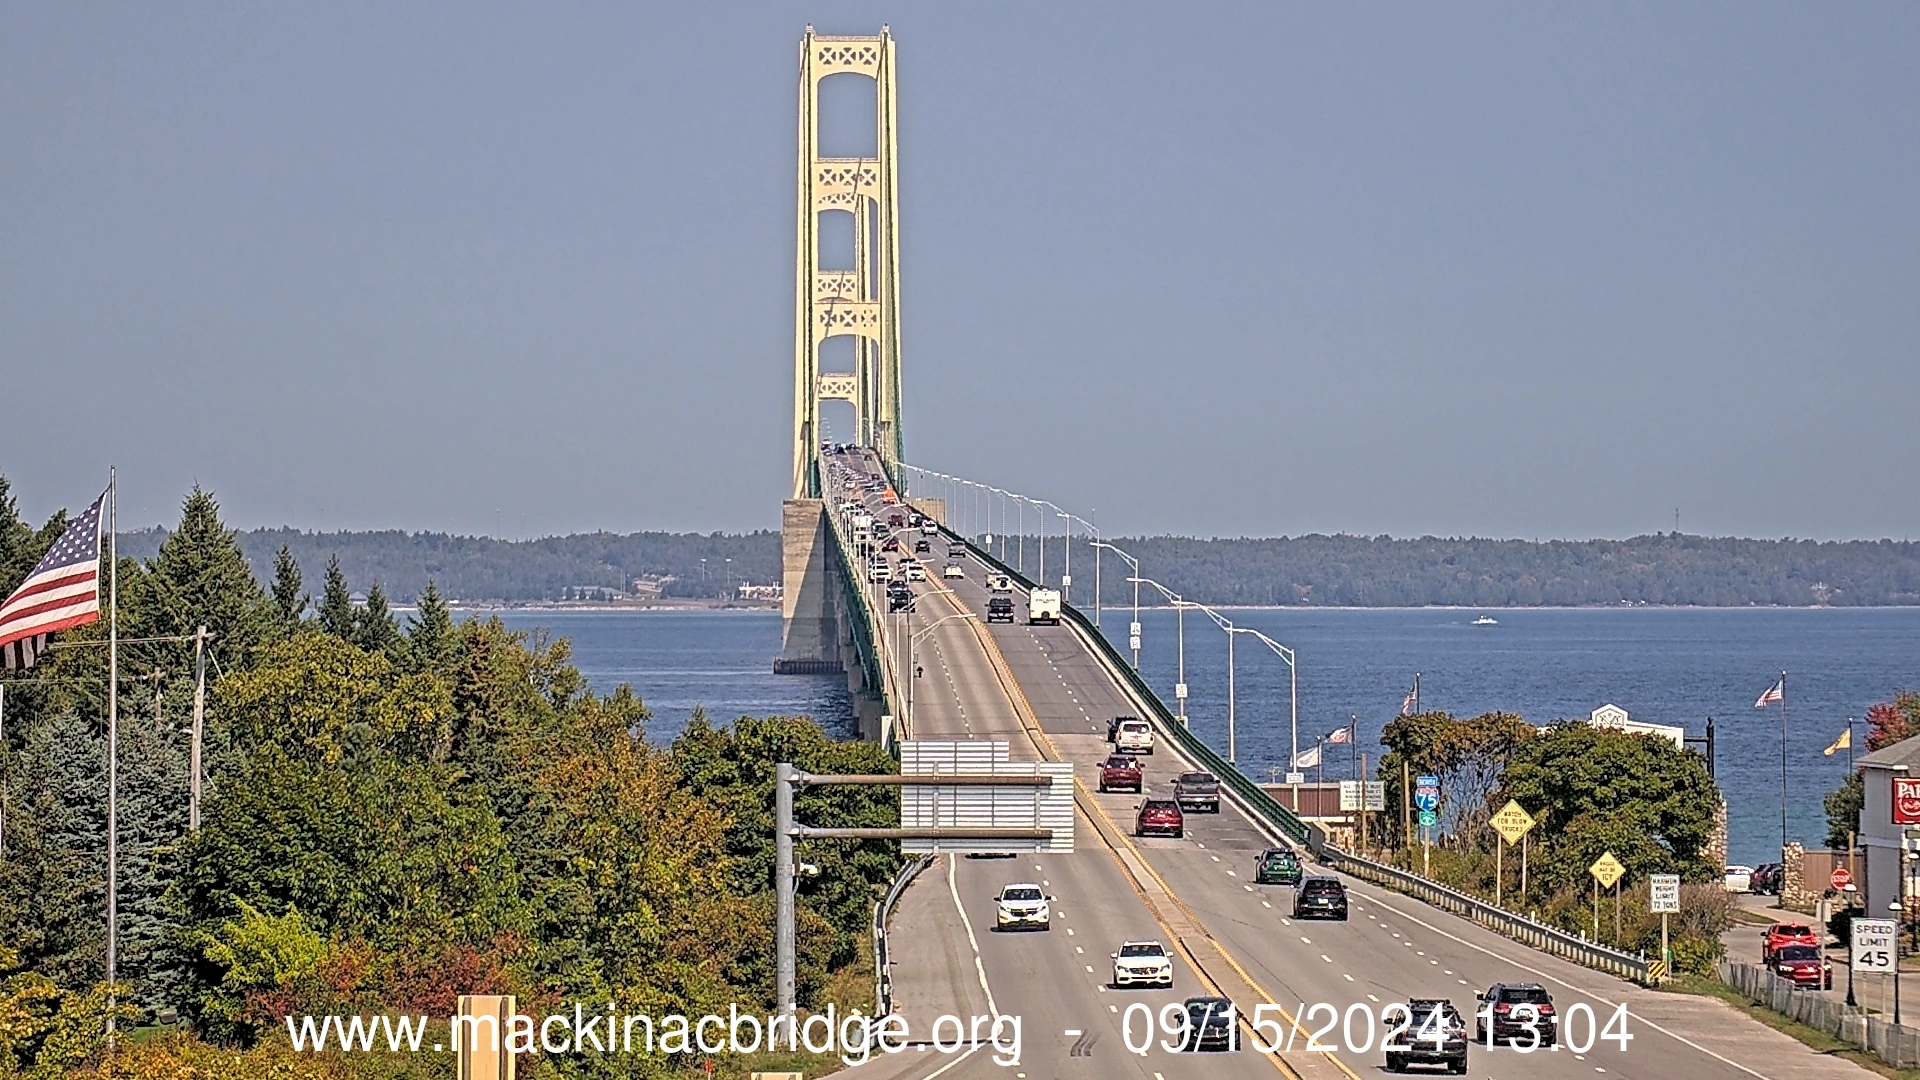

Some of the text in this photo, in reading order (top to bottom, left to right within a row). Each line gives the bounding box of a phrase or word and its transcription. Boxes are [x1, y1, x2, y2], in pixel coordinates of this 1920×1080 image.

[1418, 793, 1437, 807] 75
[1653, 901, 1661, 909] 72
[1856, 924, 1893, 934] SPEED
[1859, 937, 1889, 947] LIMIT
[1859, 951, 1890, 967] 45
